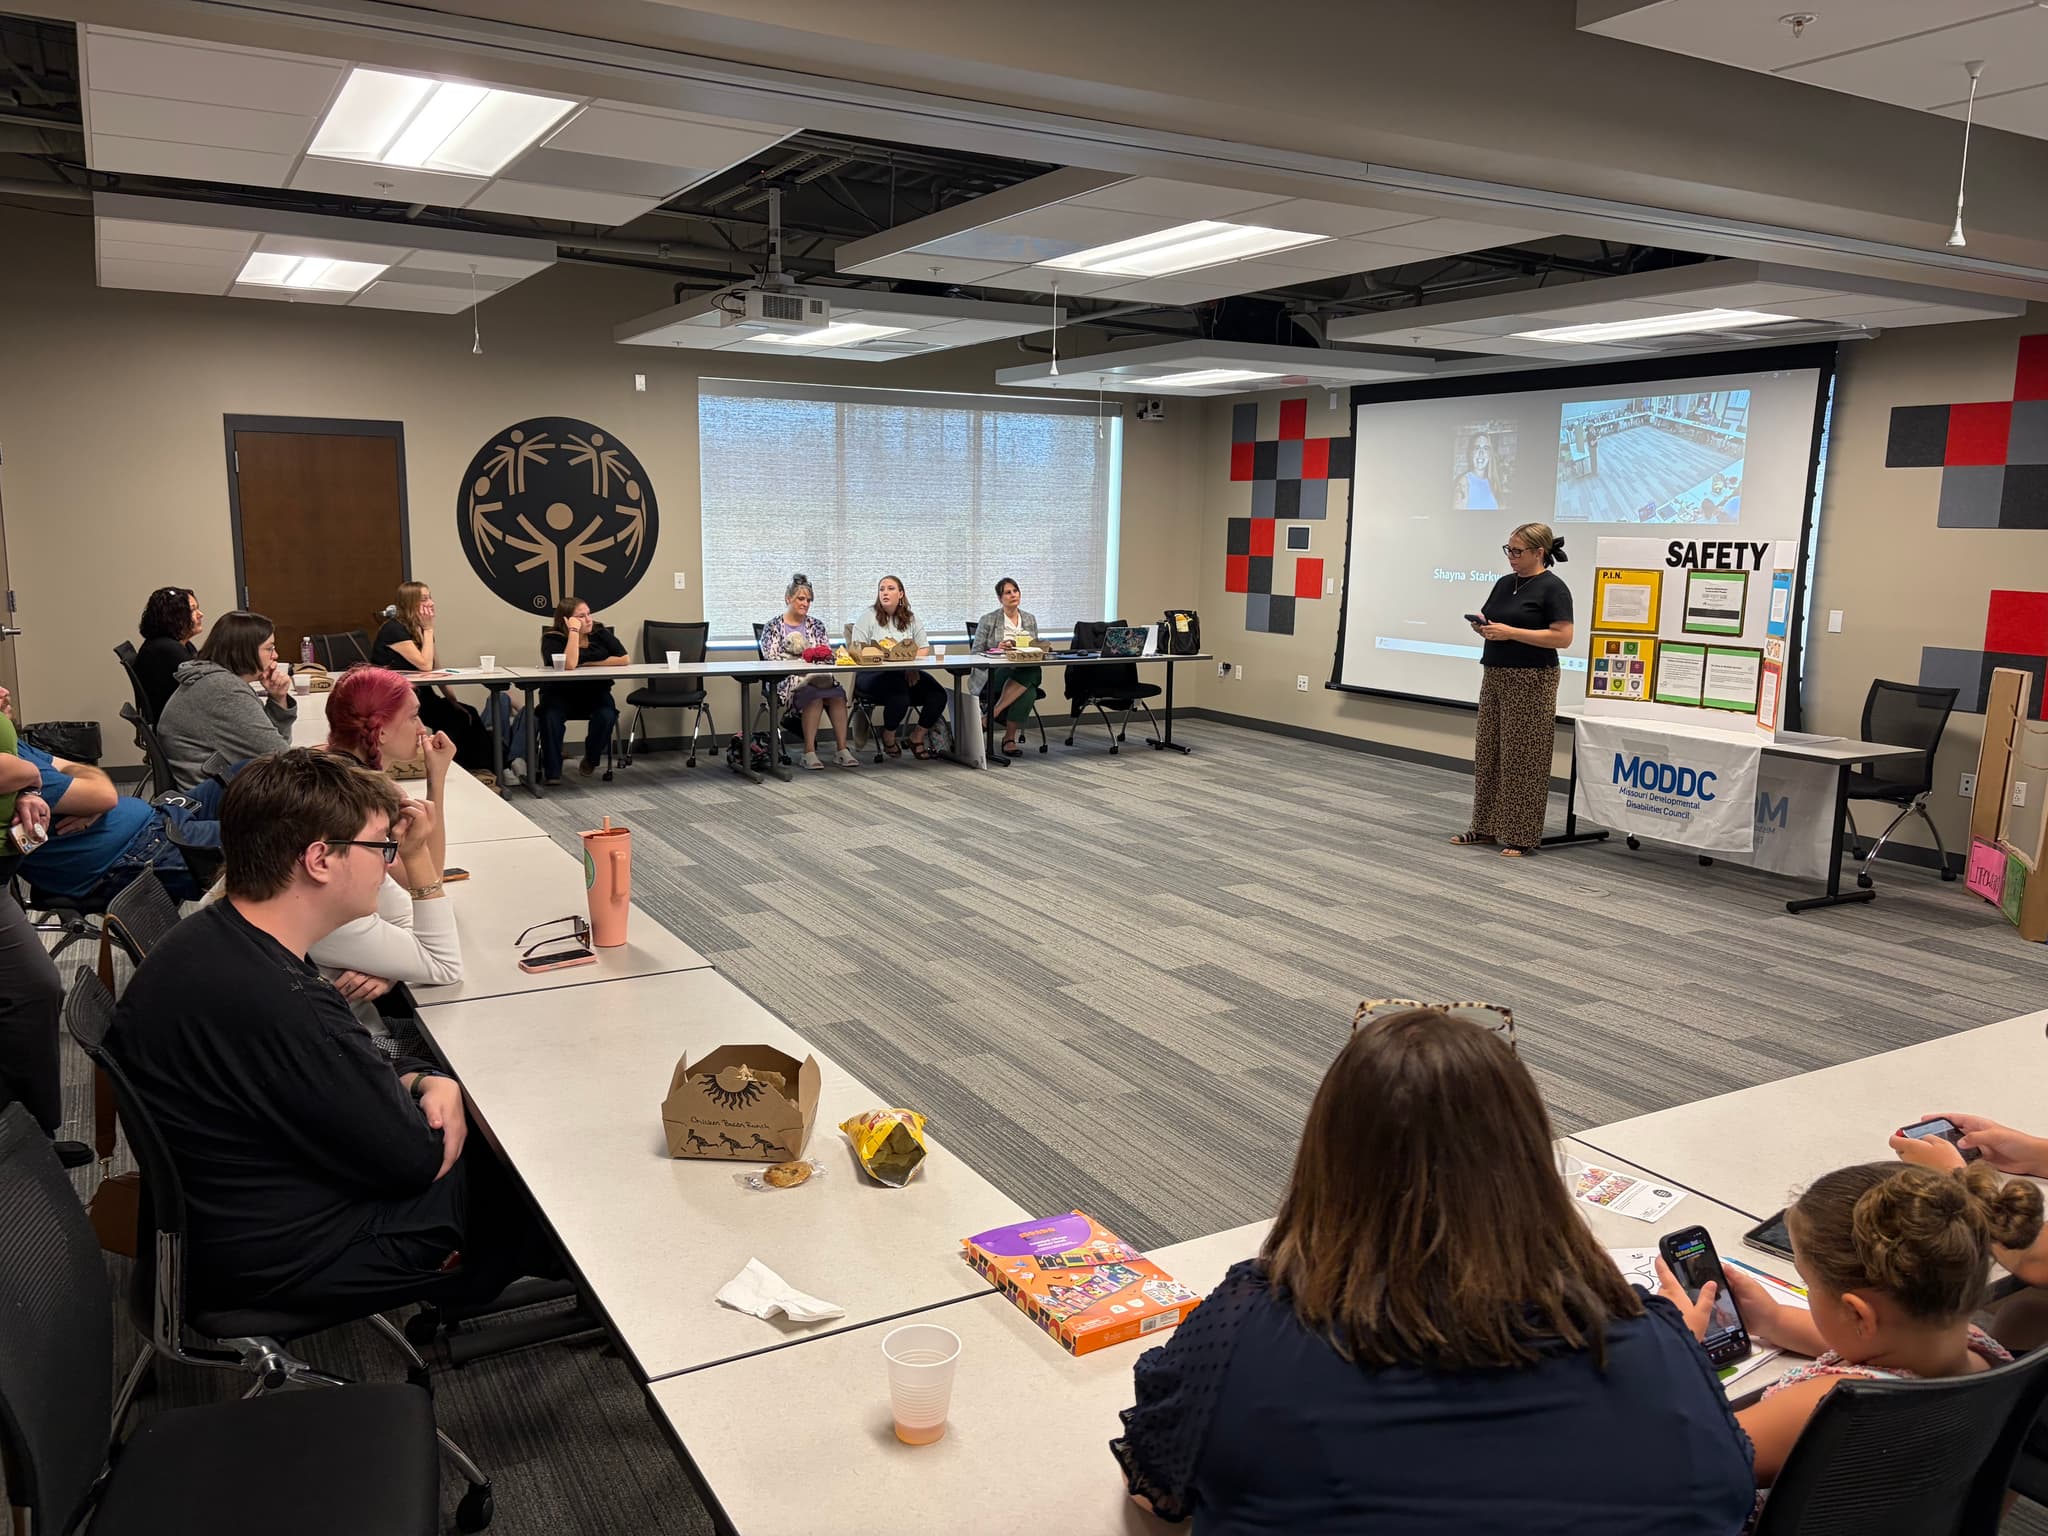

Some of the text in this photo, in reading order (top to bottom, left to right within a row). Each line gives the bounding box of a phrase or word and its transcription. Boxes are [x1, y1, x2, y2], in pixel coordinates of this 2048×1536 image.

[1665, 541, 1769, 571] SAFETY
[1433, 568, 1466, 583] Shayna
[1602, 571, 1623, 580] P.I.N.
[1612, 752, 1717, 801] MODDC
[1619, 786, 1700, 810] Missouri Developmental
[1626, 799, 1690, 820] Disabilities Council
